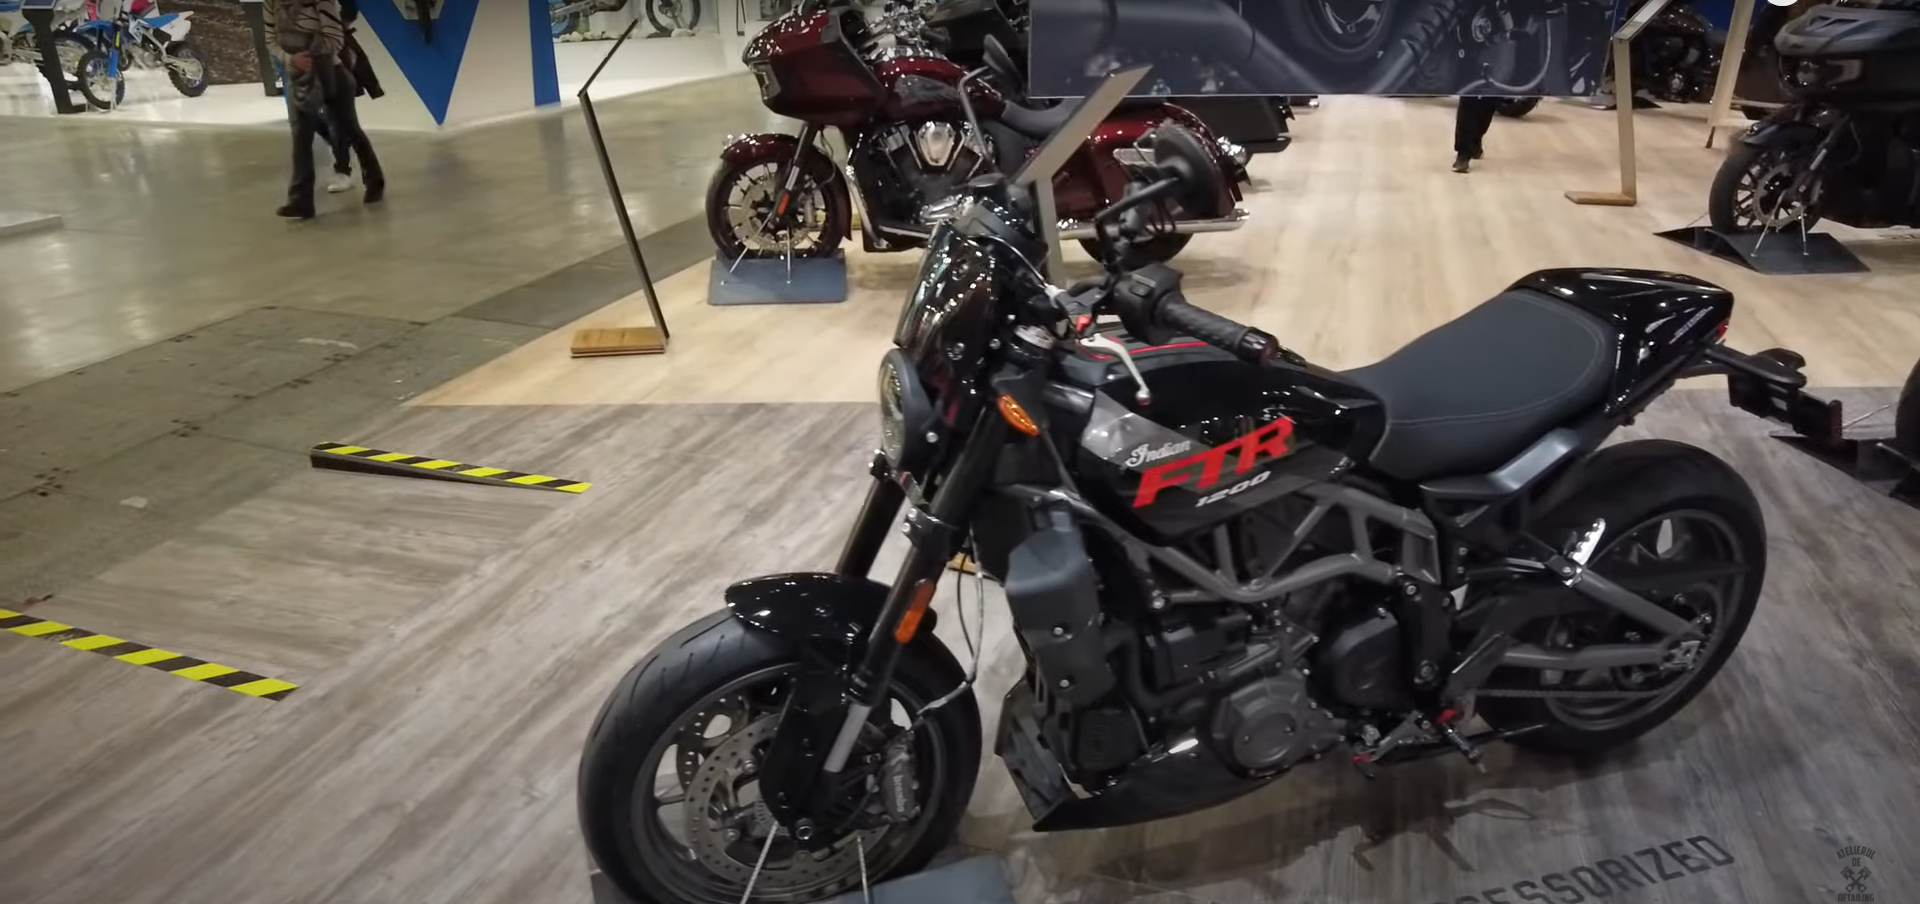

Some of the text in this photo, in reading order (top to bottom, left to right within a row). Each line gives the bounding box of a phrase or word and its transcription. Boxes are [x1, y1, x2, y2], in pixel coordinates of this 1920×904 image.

[1125, 440, 1191, 467] Indian
[1132, 415, 1294, 508] FTR
[1195, 471, 1271, 507] 1200
[1429, 835, 1736, 904] ESSORIZED
